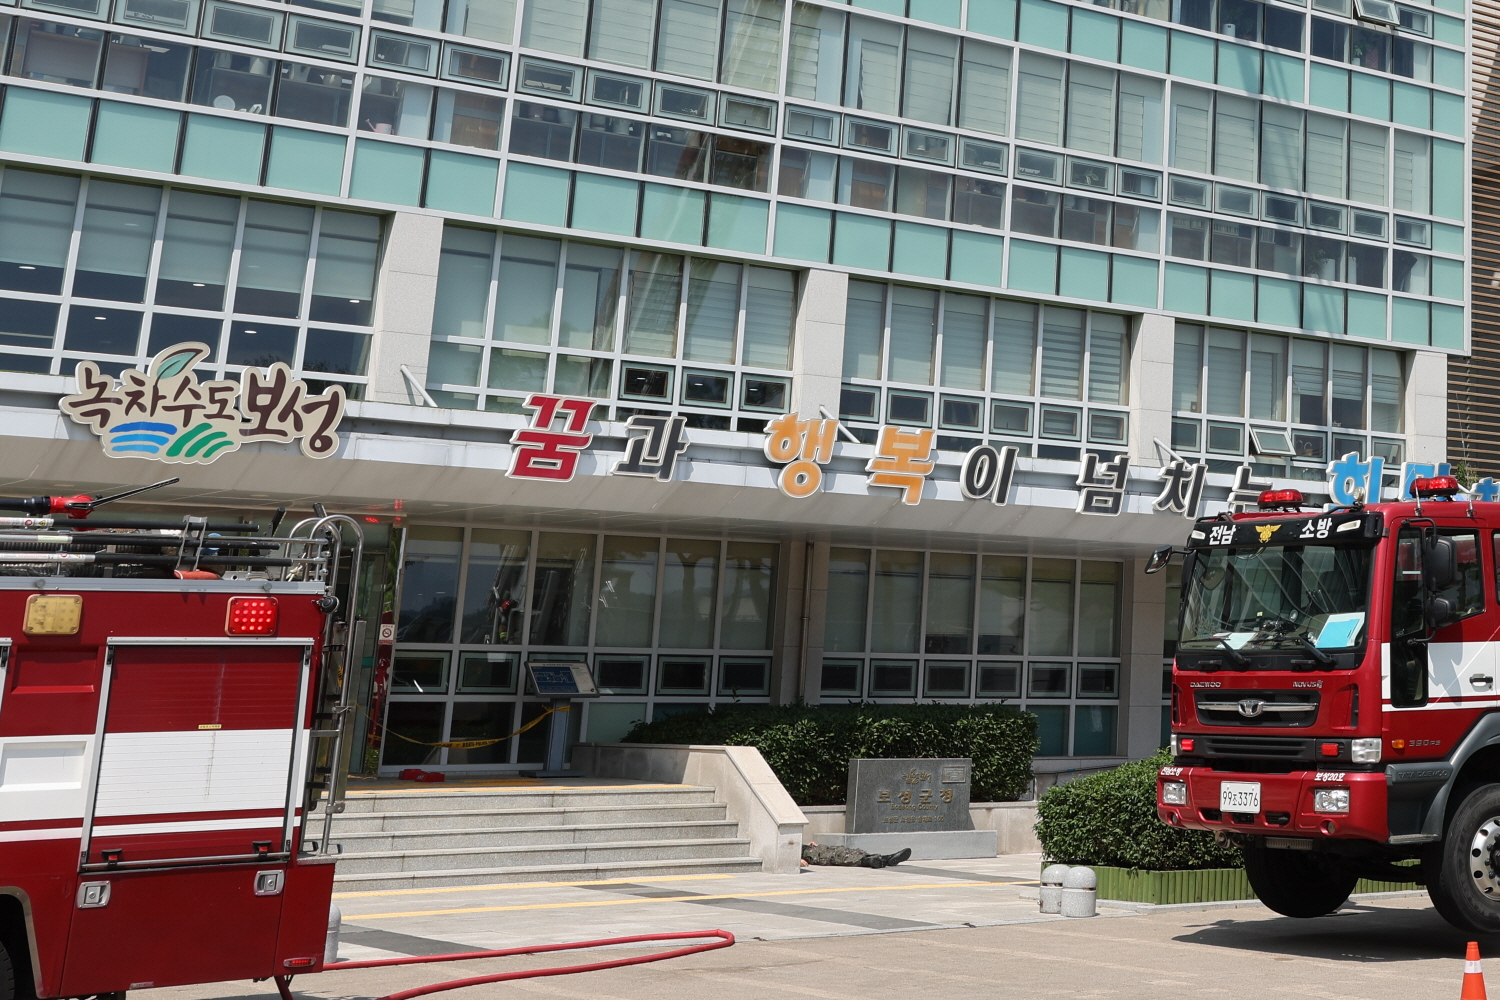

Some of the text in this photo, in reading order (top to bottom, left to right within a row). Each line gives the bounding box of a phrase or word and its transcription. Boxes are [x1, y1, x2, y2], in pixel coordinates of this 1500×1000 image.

[506, 394, 690, 483] 꿈과
[764, 412, 1019, 507] 행복이
[1209, 517, 1333, 545] 전남 소방
[1314, 771, 1346, 782] 보성20호
[877, 788, 954, 804] 보성군청
[1222, 791, 1259, 807] 99조3376
